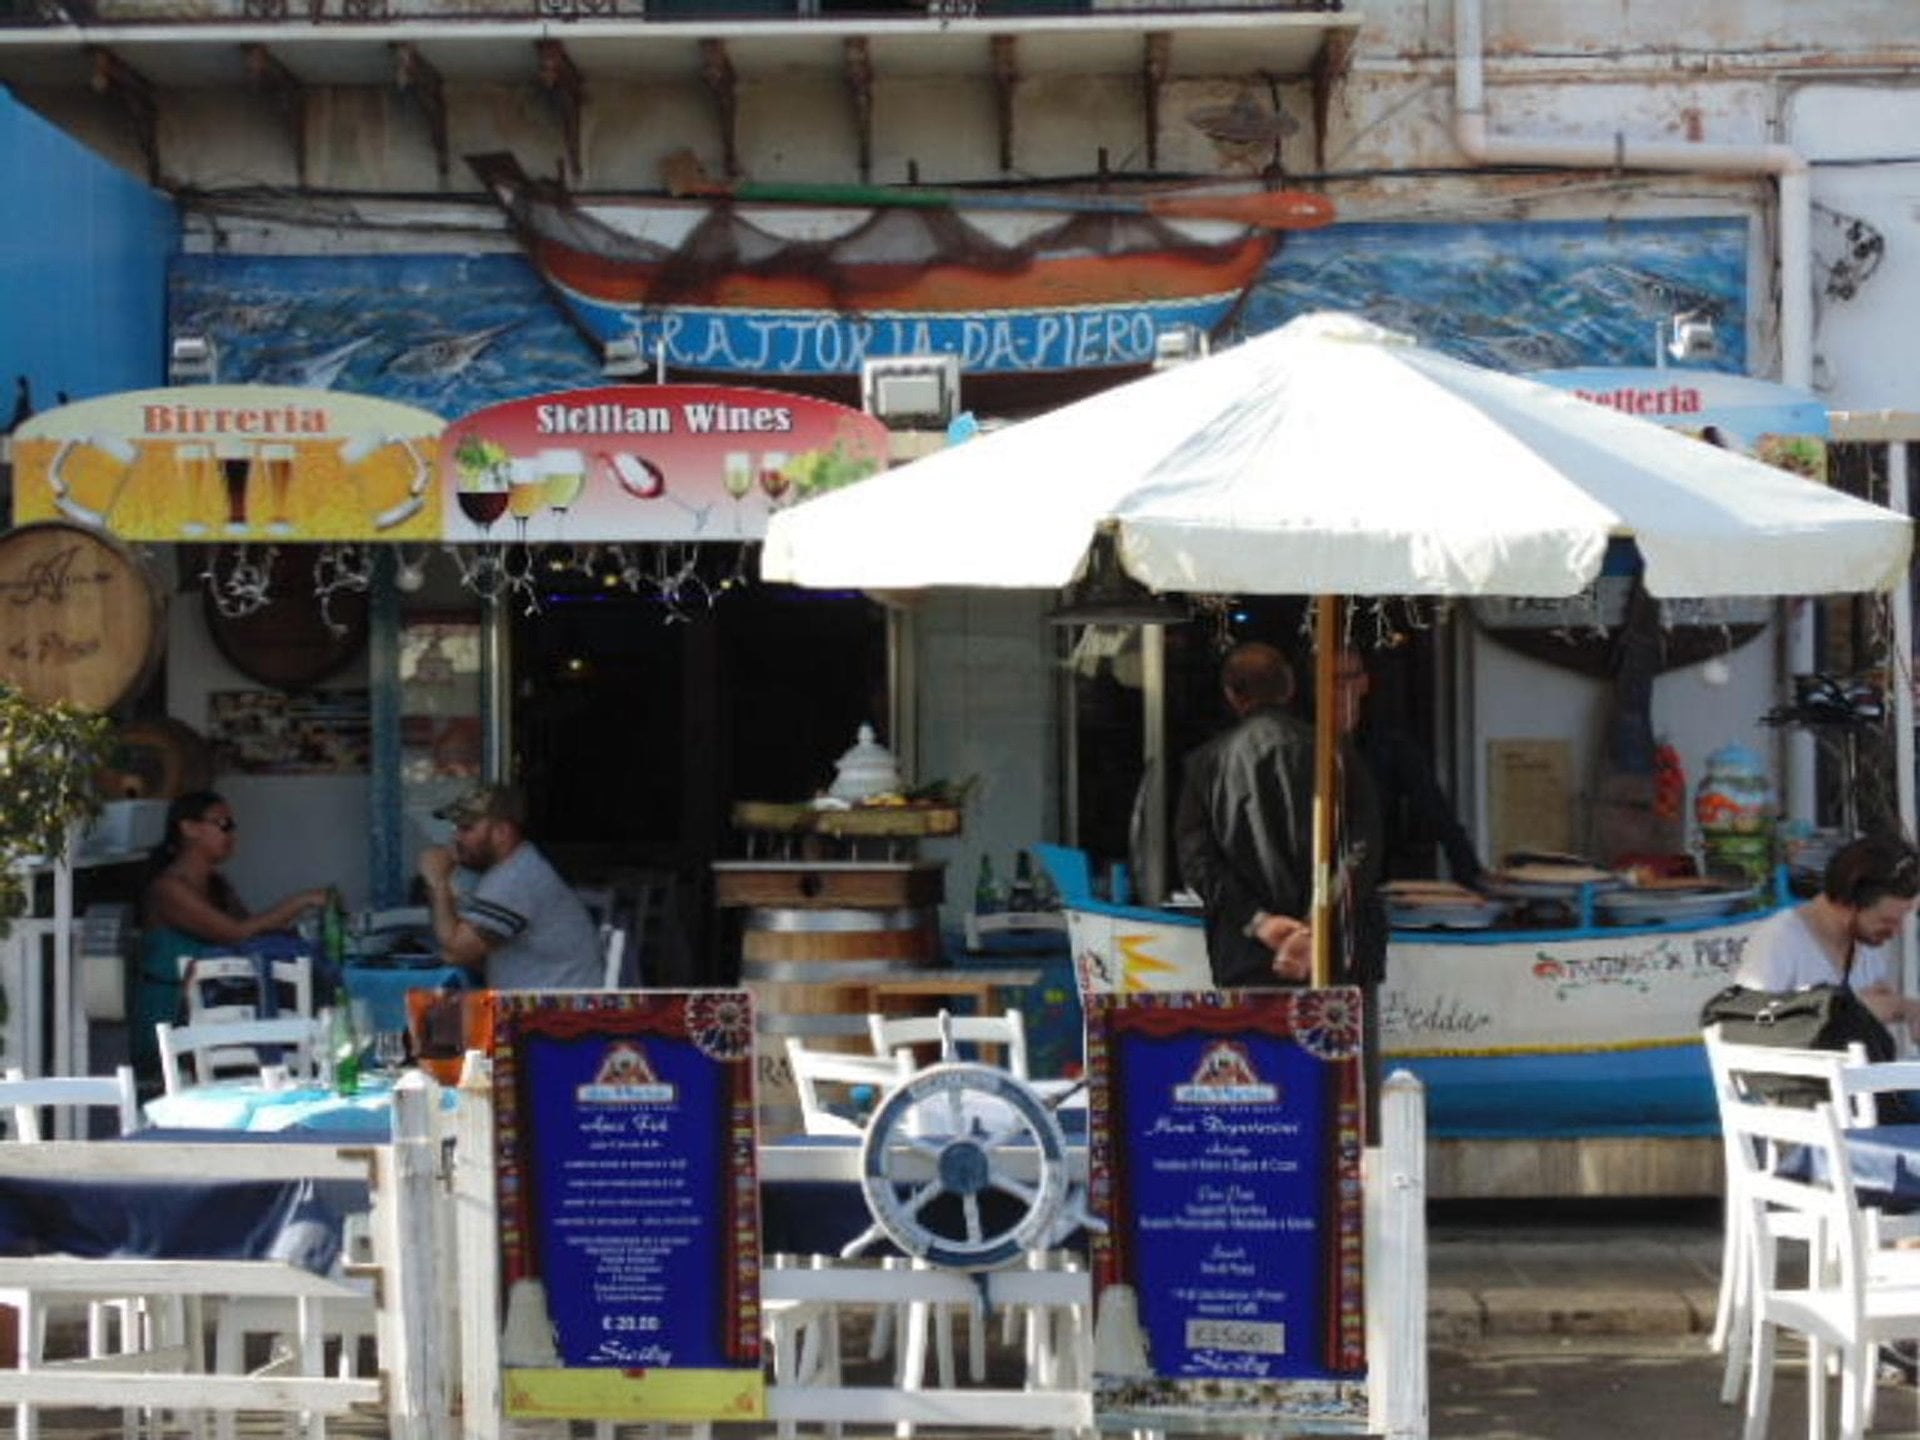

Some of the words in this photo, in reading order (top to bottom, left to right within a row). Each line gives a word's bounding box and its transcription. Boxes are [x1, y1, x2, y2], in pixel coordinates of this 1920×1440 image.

[1031, 311, 1156, 368] PIERO
[143, 403, 330, 434] Birreria
[536, 402, 670, 434] Sicilian
[684, 403, 793, 434] Wines
